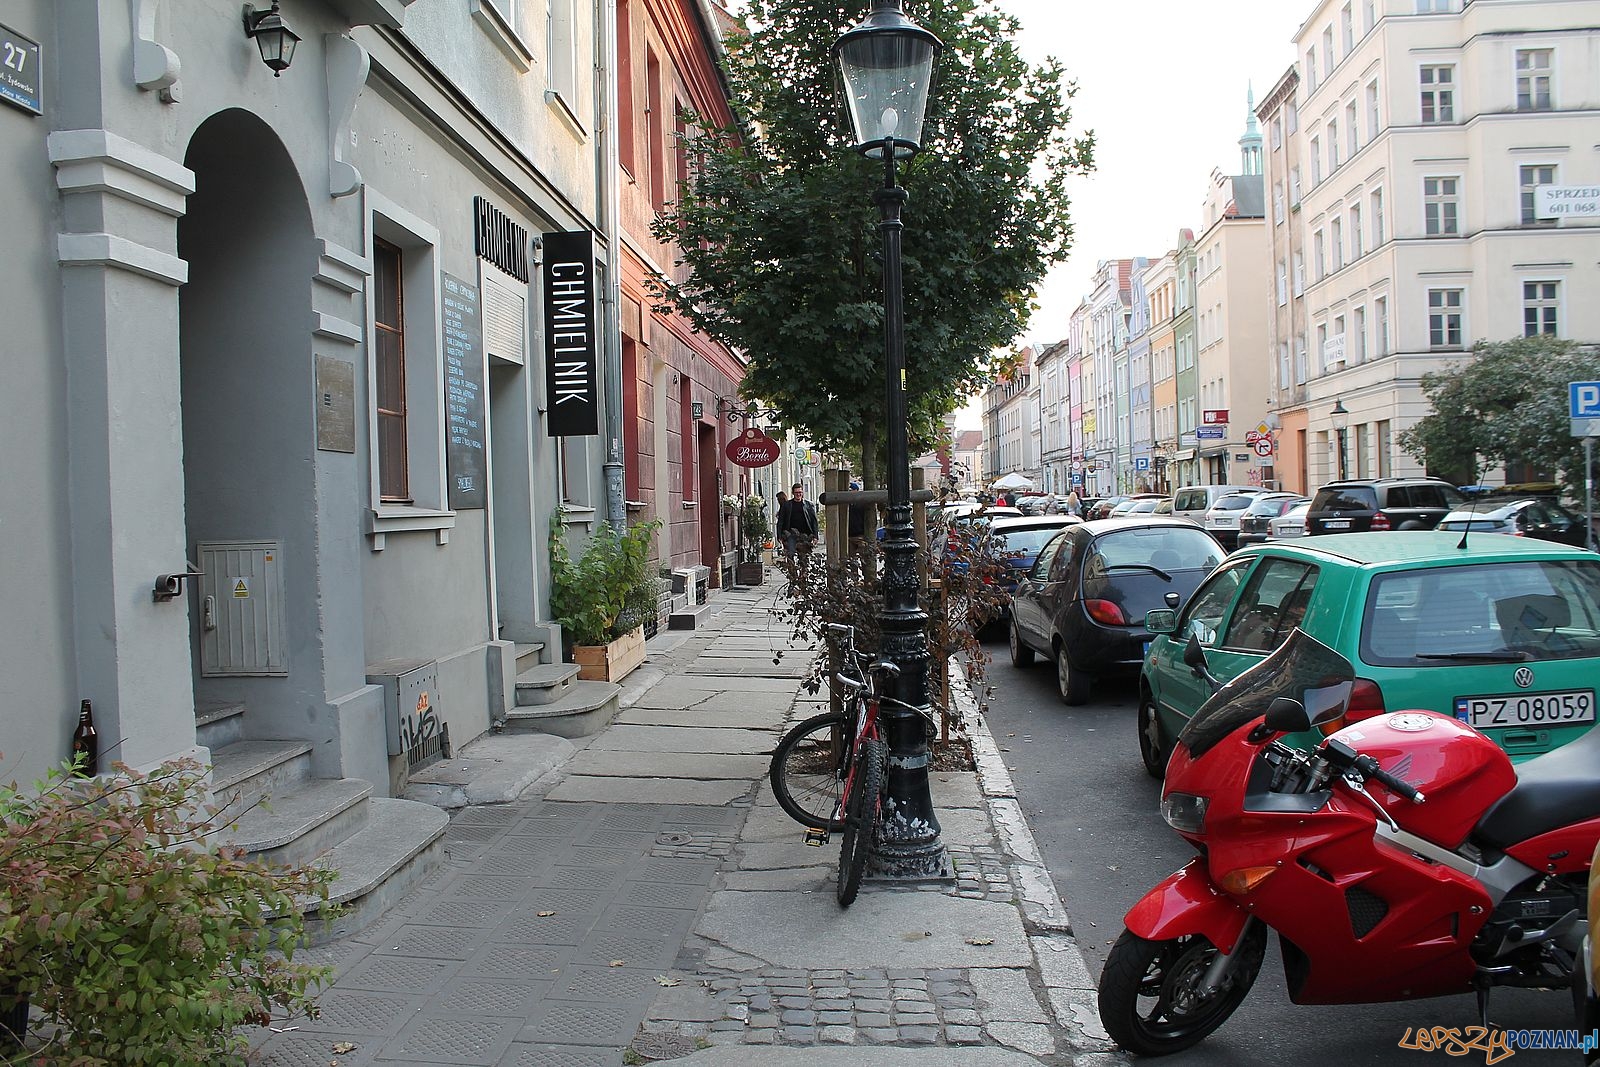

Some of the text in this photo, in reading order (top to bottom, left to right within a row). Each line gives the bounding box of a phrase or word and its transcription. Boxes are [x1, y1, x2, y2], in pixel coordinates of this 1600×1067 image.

[4, 42, 27, 72] 27
[7, 73, 34, 95] Żydowska
[1549, 204, 1570, 214] 601
[551, 261, 589, 405] CHMIELNIK
[736, 446, 770, 460] Bordo
[1472, 694, 1590, 725] PZ 08059
